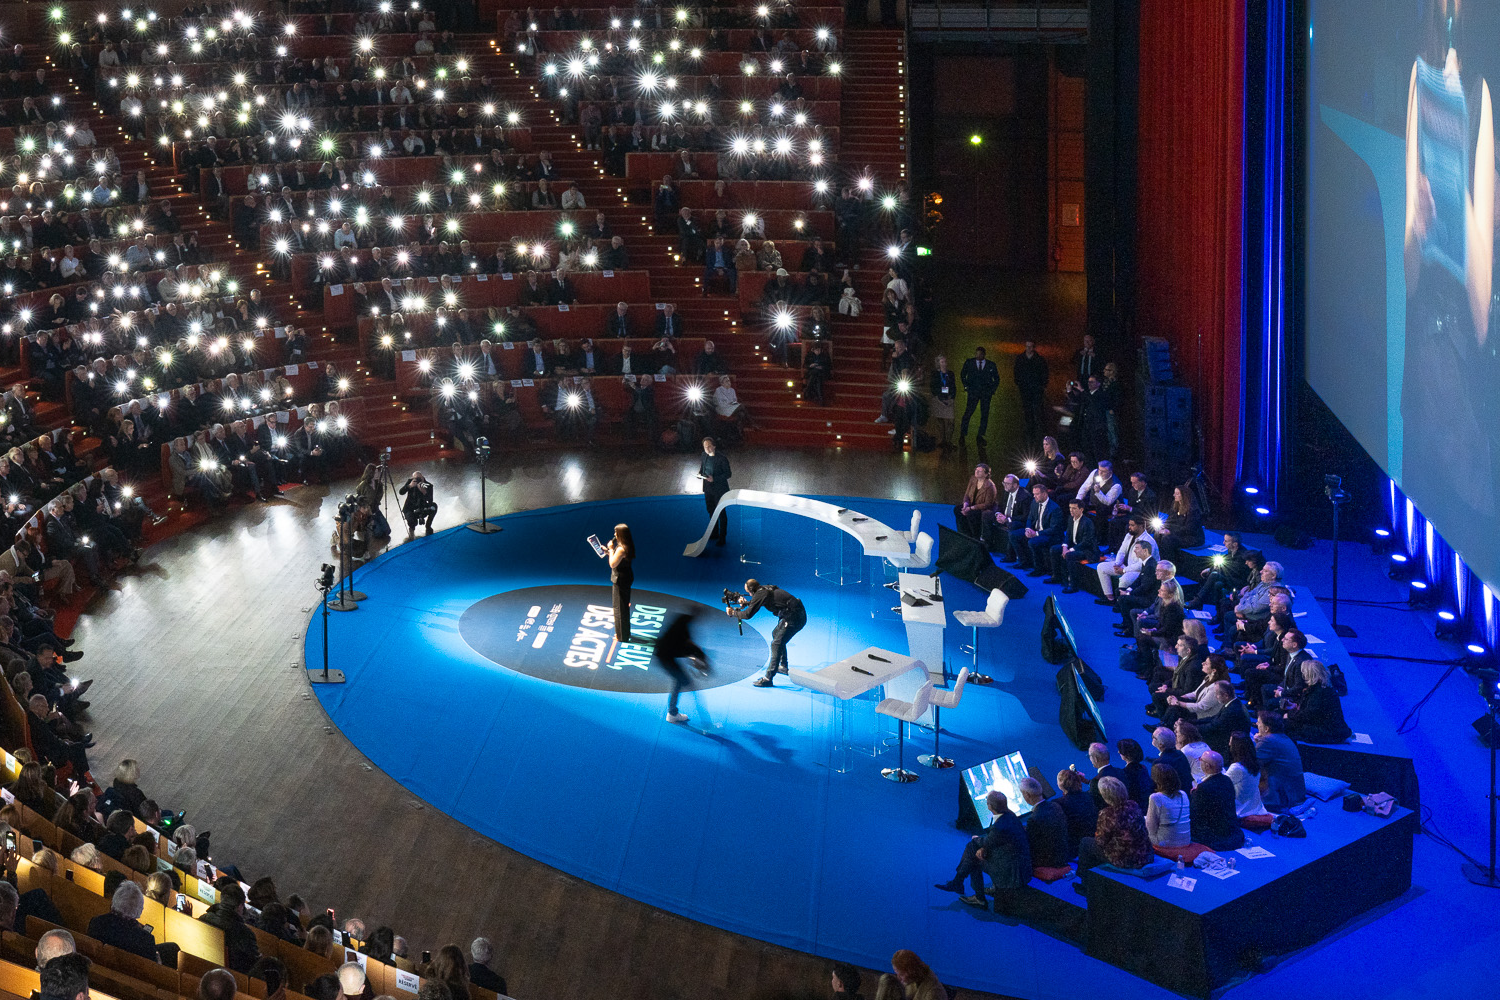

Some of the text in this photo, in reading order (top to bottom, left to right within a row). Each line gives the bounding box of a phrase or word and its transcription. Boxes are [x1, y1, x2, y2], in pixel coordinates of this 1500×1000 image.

[580, 604, 615, 630] DES
[630, 603, 667, 629] DES
[563, 626, 610, 670] ACTES
